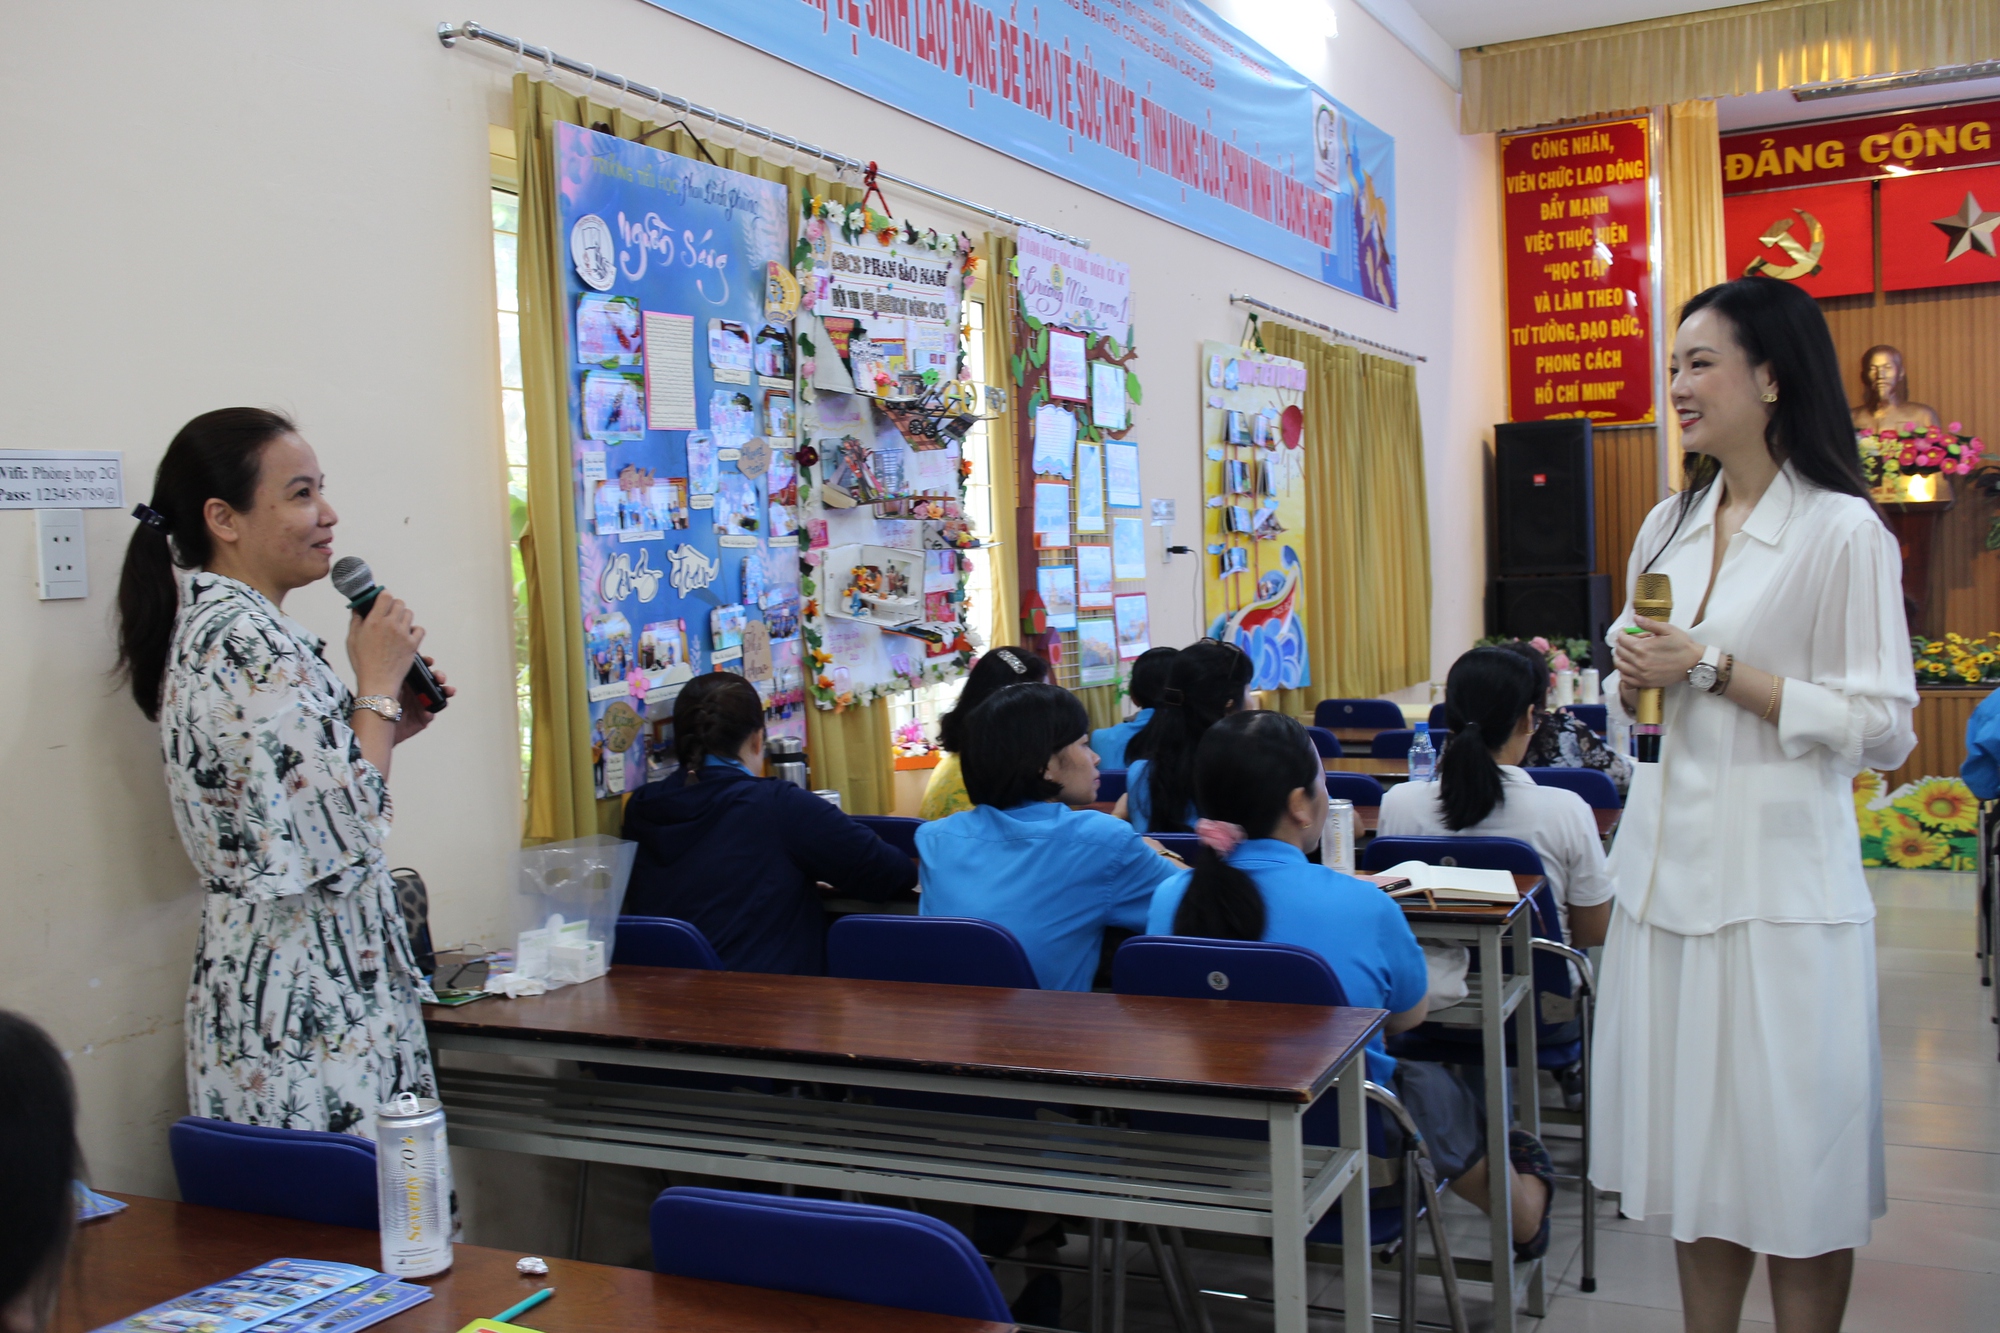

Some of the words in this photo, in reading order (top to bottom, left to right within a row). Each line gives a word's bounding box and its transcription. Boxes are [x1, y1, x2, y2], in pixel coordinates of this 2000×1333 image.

[1123, 24, 1151, 54] CÔNG
[1179, 59, 1198, 82] CÁC
[1023, 5, 1053, 122] BẢO
[1054, 35, 1075, 154] VỆ
[1076, 43, 1102, 145] SỨC
[1201, 106, 1222, 201] CỦA
[1531, 137, 1569, 160] CÔNG
[1572, 130, 1615, 154] NHÂN,
[1724, 138, 1845, 182] ĐẢNG
[1859, 121, 1991, 167] CỘNG
[1506, 170, 1536, 194] VIÊN
[1538, 165, 1574, 190] CHỨC
[1576, 165, 1603, 185] LAO
[1605, 158, 1644, 185] ĐỘNG
[1540, 192, 1565, 221] ĐẨY
[1569, 195, 1609, 219] MẠNH
[1524, 230, 1554, 255] VIỆC
[1557, 226, 1593, 251] THỰC
[1595, 221, 1628, 247] HIỆN
[863, 256, 896, 278] PHAN
[920, 267, 949, 287] NAM
[1582, 254, 1609, 281] TẬP
[1534, 290, 1551, 313] VÀ
[1554, 288, 1584, 311] LÀM
[1586, 287, 1623, 309] THEO
[1511, 323, 1530, 346] TƯ
[1611, 314, 1644, 339] ĐỨC,
[1536, 352, 1581, 374] PHONG
[1585, 347, 1622, 370] CÁCH
[1535, 379, 1553, 405] HỒ
[1556, 379, 1579, 403] CHÍ
[32, 466, 71, 483] Phòng
[73, 466, 97, 483] họp
[401, 1149, 417, 1170] 70
[405, 1174, 425, 1243] Seventy
